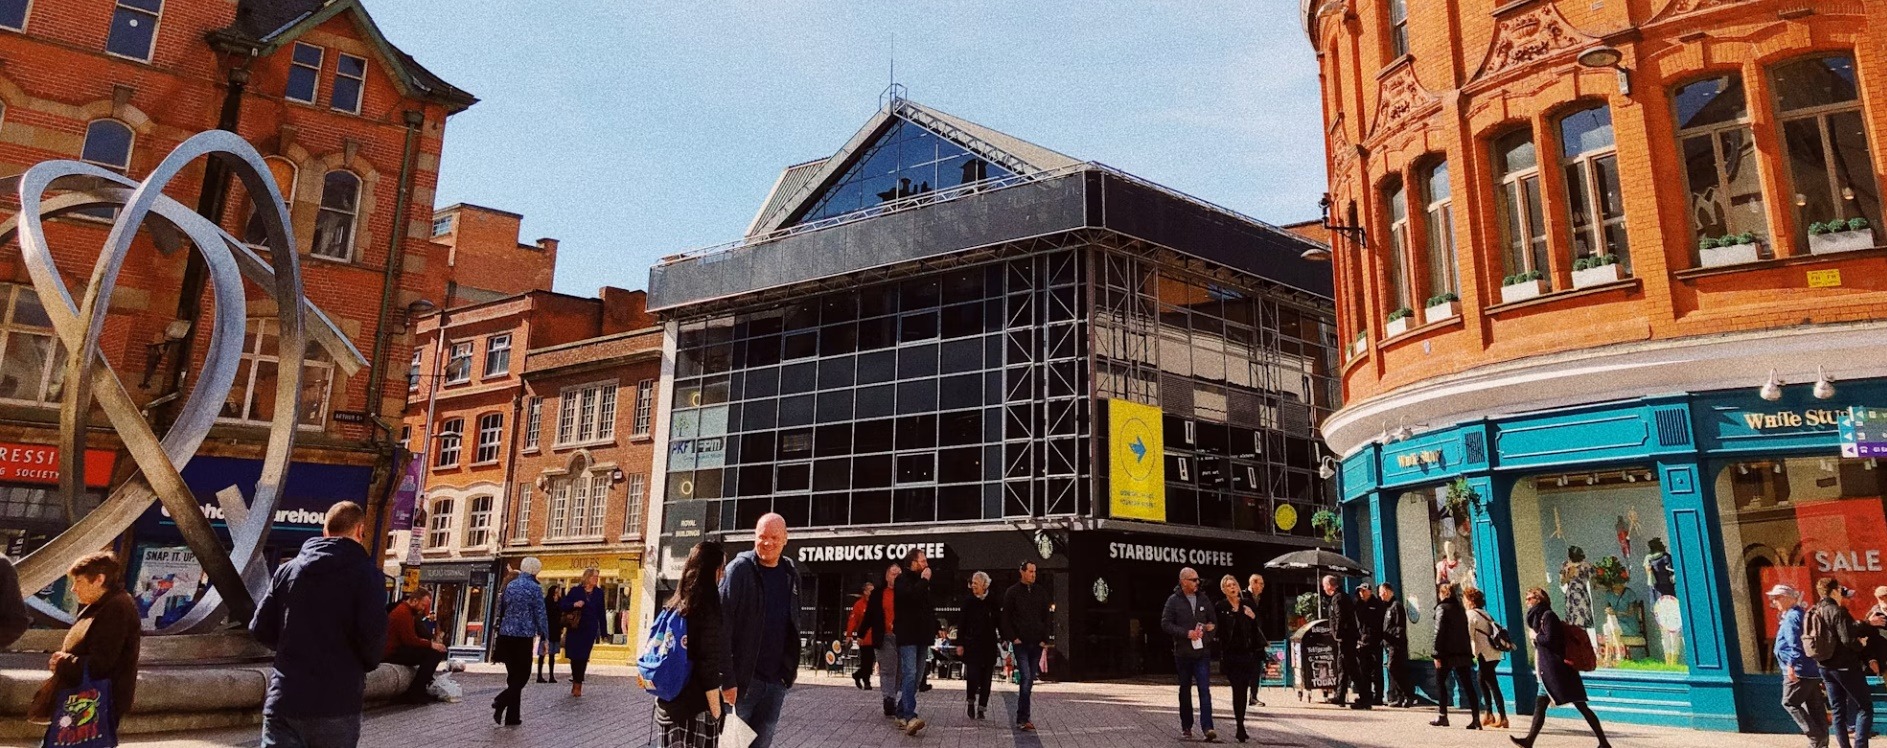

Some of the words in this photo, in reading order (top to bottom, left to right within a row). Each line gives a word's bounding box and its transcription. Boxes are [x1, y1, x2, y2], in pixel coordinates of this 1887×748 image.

[672, 440, 690, 454] PKF
[0, 447, 56, 465] RESSI
[16, 468, 60, 479] SOCIETY
[680, 519, 698, 527] ROYAL
[675, 529, 701, 538] BUILDINGS
[146, 551, 169, 561] SNAP.
[171, 552, 181, 561] IT.
[798, 544, 883, 562] STARBUCKS
[1109, 542, 1187, 564] STARBUCKS
[1189, 549, 1234, 567] COFFEE
[569, 557, 600, 569] JOULES
[1815, 549, 1882, 572] SALE
[1311, 677, 1337, 687] TODAY
